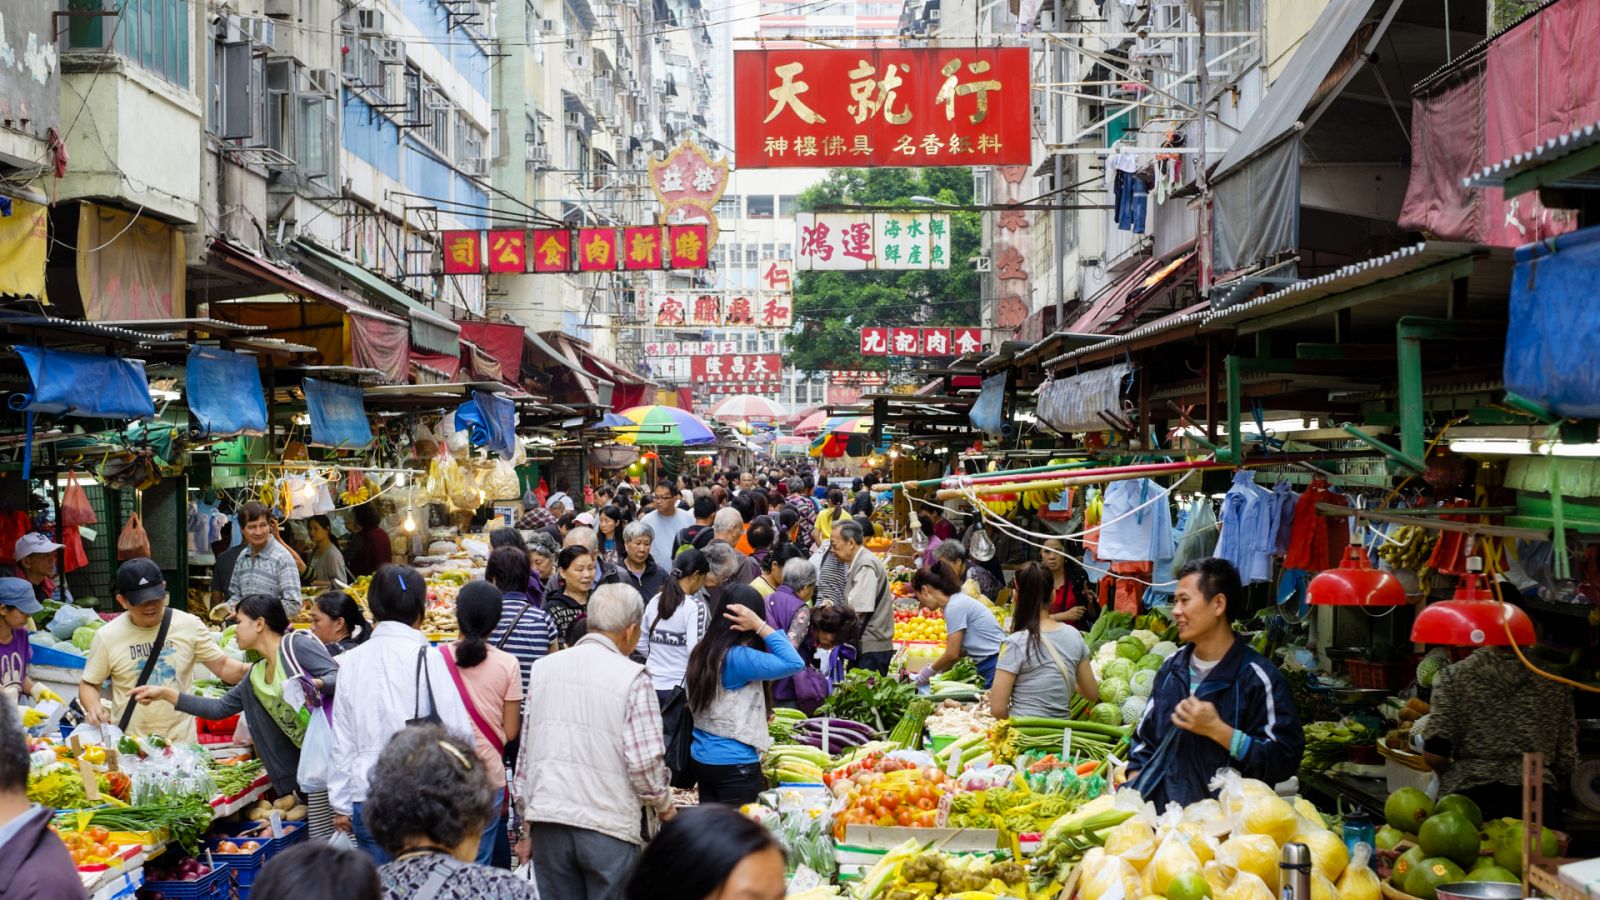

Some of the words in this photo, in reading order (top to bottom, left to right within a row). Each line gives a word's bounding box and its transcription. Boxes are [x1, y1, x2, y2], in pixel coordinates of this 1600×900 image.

[763, 57, 1002, 125] 天就行
[892, 133, 1003, 156] 名香紙料
[800, 222, 877, 262] 鴻運
[863, 330, 981, 354] 九記肉食
